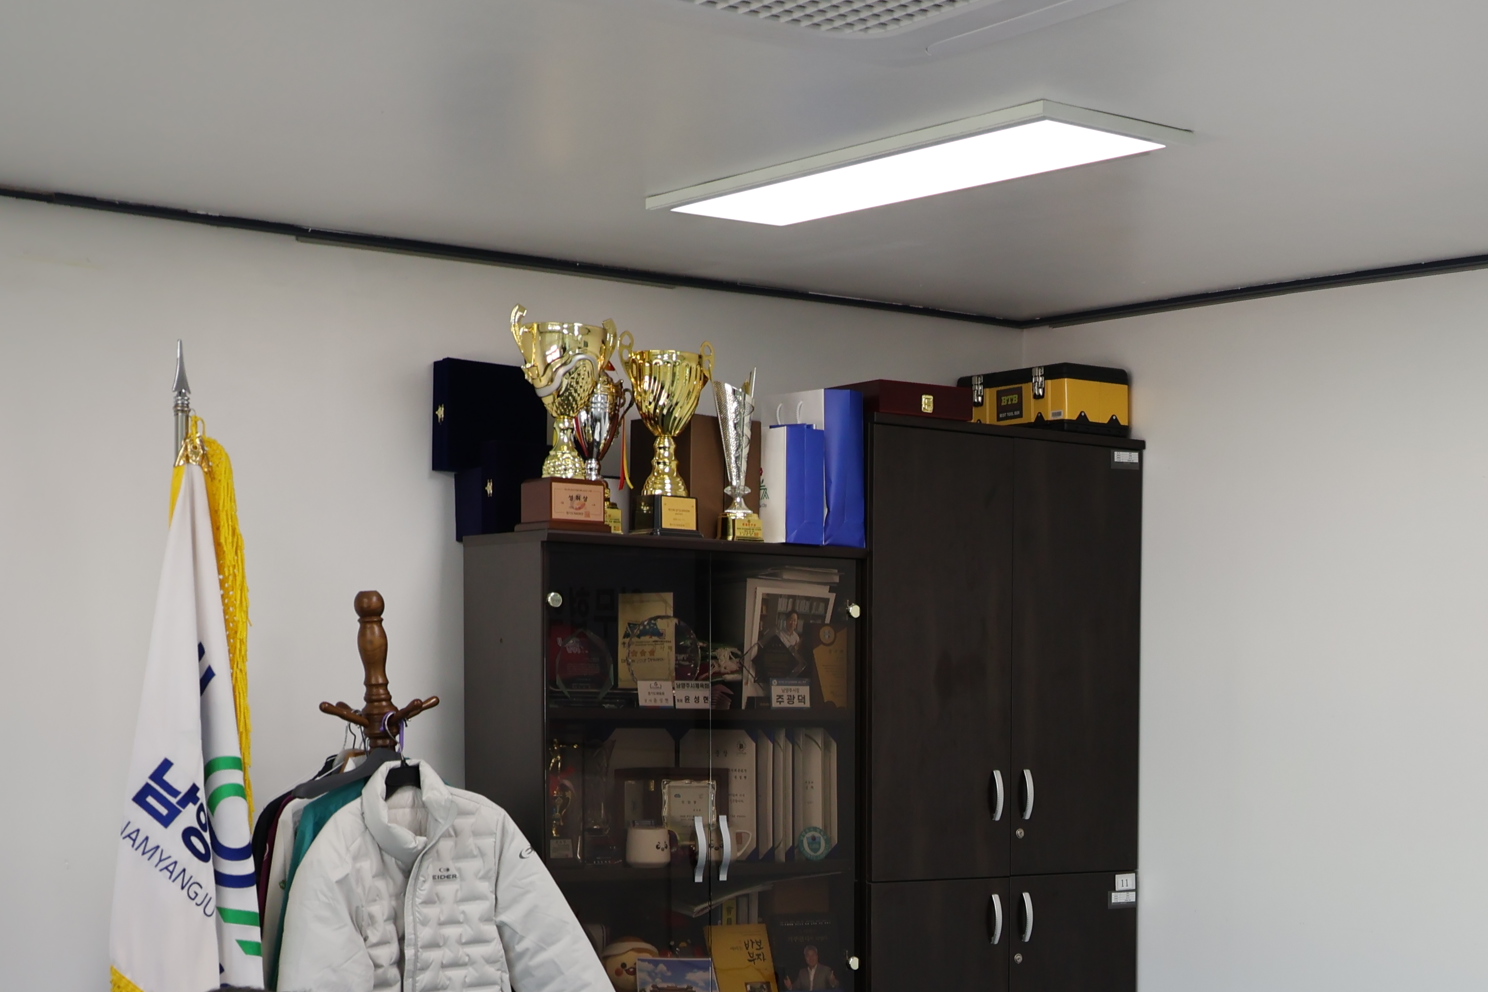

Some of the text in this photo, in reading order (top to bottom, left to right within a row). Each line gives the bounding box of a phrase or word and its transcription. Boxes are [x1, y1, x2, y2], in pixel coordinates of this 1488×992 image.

[1001, 394, 1018, 406] BTB
[432, 873, 458, 881] EIDER
[744, 938, 764, 951] 바보
[747, 951, 767, 966] 부자
